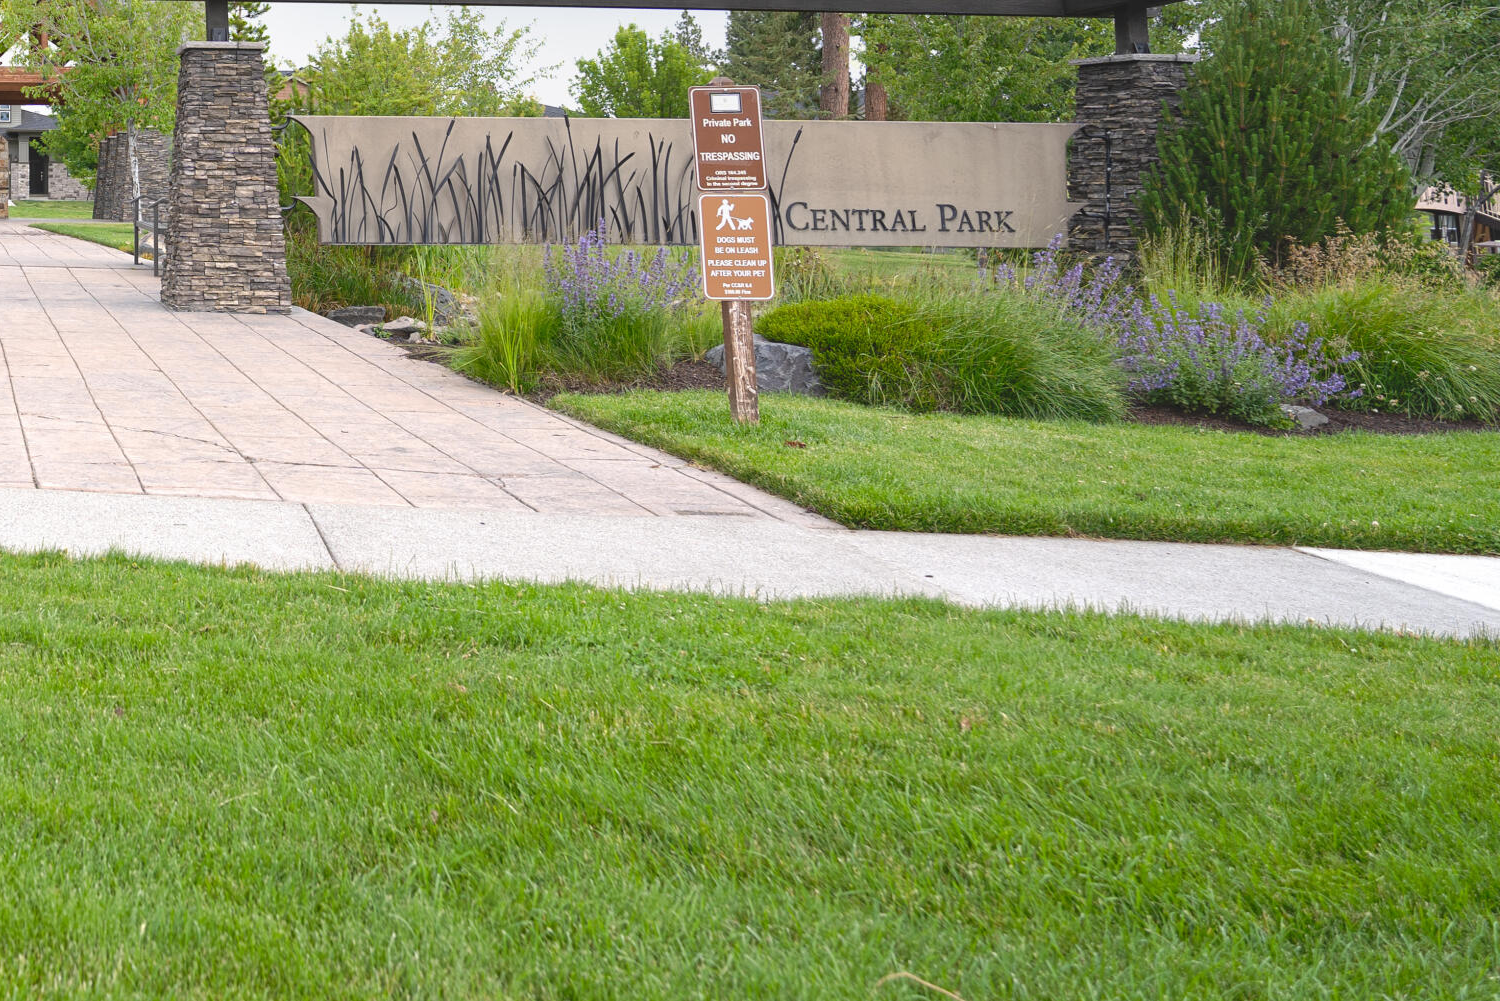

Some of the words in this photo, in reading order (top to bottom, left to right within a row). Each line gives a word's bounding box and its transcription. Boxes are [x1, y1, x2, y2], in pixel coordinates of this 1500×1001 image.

[702, 118, 731, 128] Private
[732, 117, 752, 127] Park
[720, 133, 736, 144] NO
[699, 151, 761, 161] TRESPASSING
[785, 201, 927, 232] CENTRAL
[935, 202, 1017, 234] PARK
[716, 236, 736, 244] DOGS
[736, 236, 755, 244] MUST
[714, 246, 725, 254] BE
[725, 246, 736, 254] ON
[736, 246, 759, 254] LEASH
[707, 259, 734, 267] PLEASE
[733, 259, 757, 267] CLEAN
[757, 259, 767, 267] UP
[710, 269, 733, 277] AFTER
[732, 269, 752, 277] YOUR
[752, 269, 766, 278] PET
